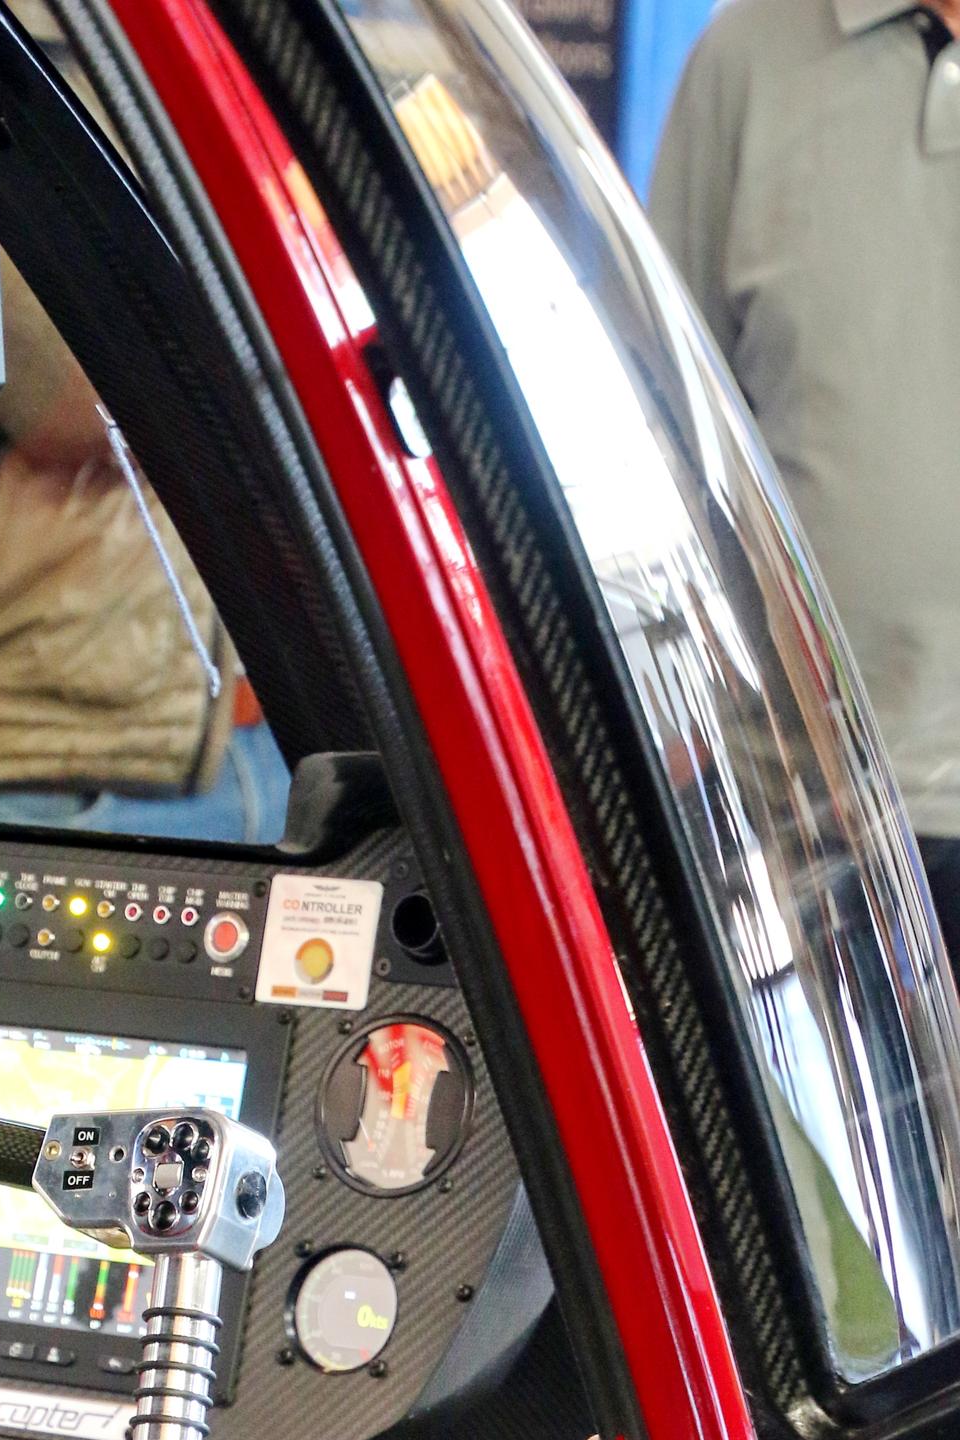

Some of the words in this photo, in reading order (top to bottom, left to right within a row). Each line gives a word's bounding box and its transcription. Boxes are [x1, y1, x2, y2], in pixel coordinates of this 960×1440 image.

[283, 899, 363, 916] CONTROLLER
[77, 1131, 95, 1142] ON
[67, 1175, 91, 1187] OFF
